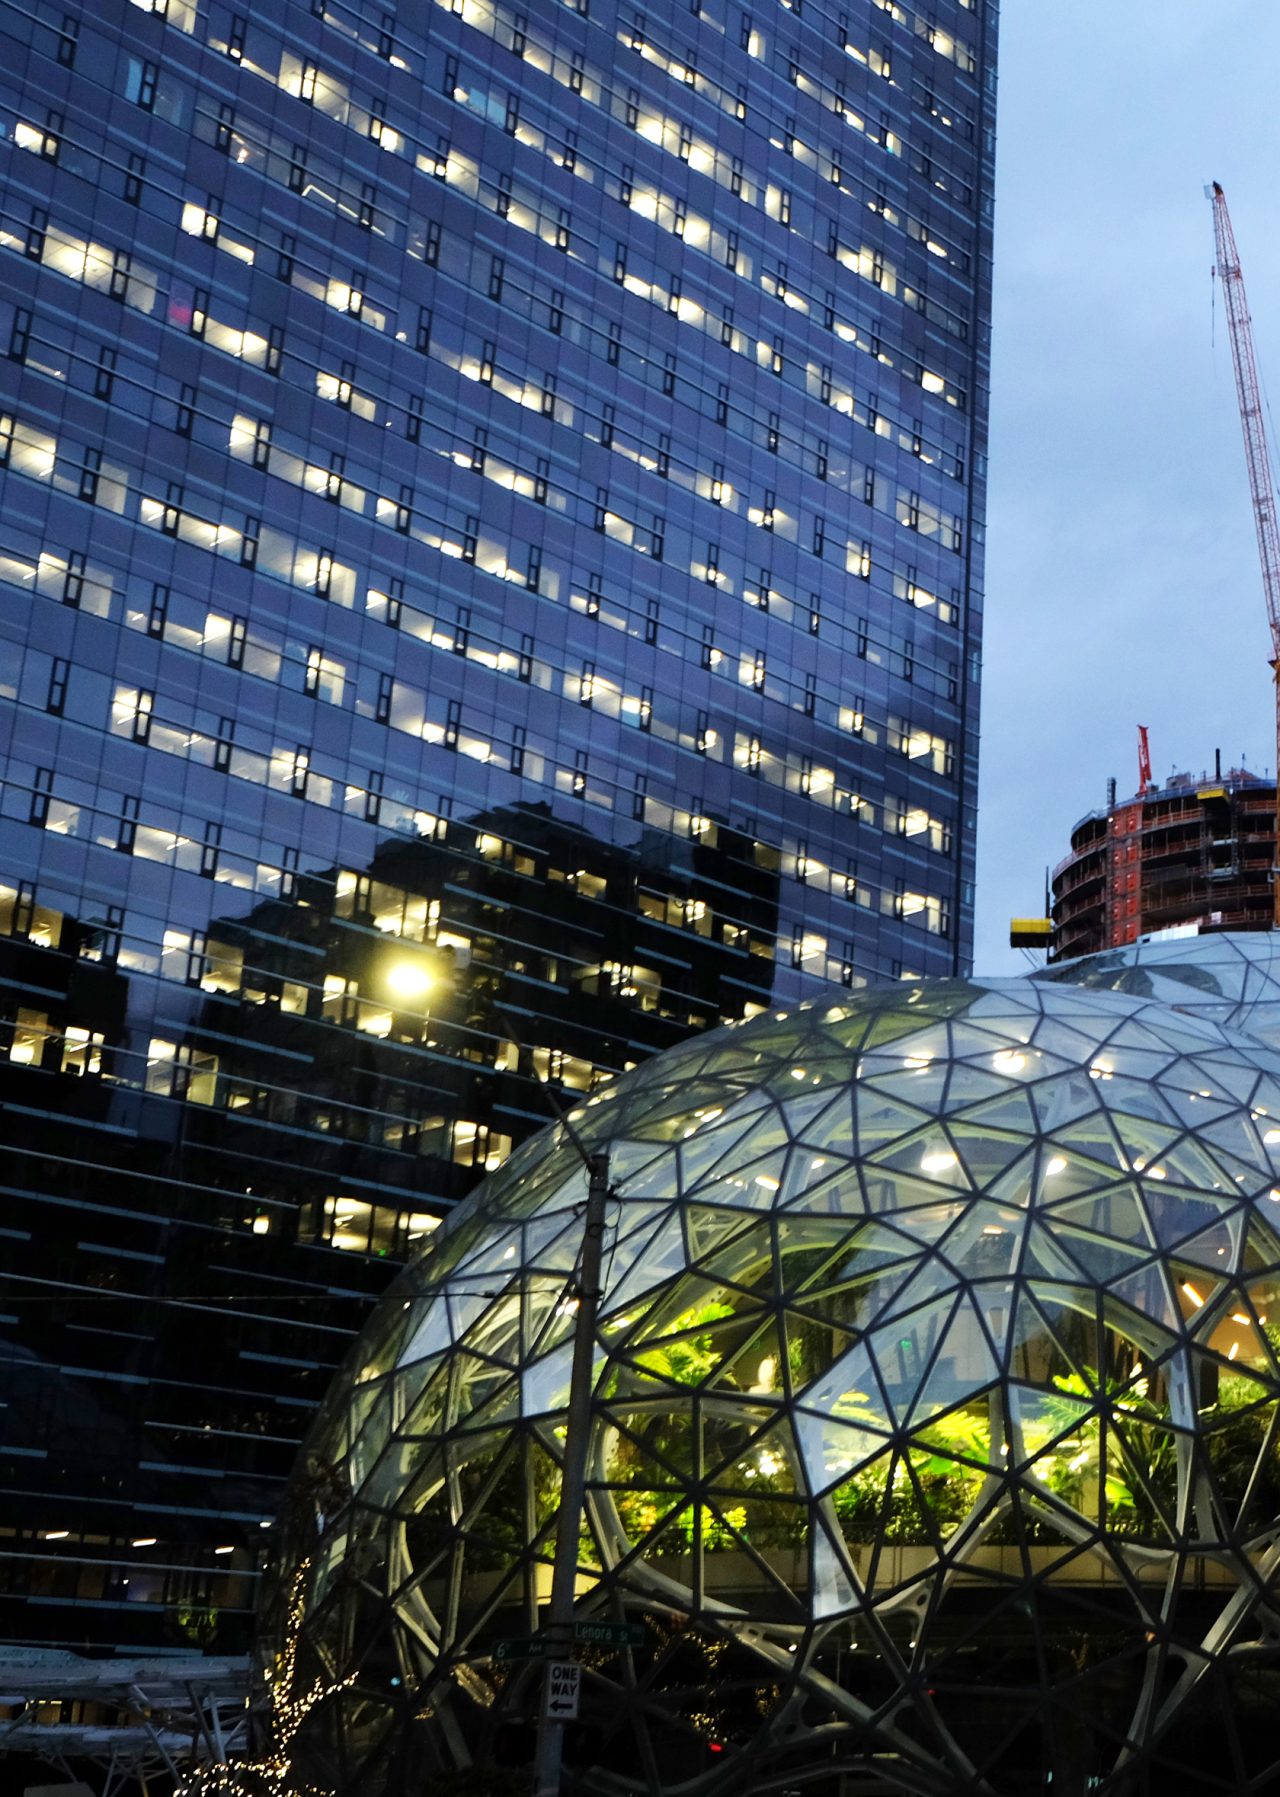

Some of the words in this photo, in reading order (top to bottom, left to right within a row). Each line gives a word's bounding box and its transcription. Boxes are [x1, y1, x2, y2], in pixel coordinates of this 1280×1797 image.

[575, 1622, 612, 1640] Lenora
[552, 1666, 578, 1681] ONE
[551, 1682, 578, 1696] WAY
